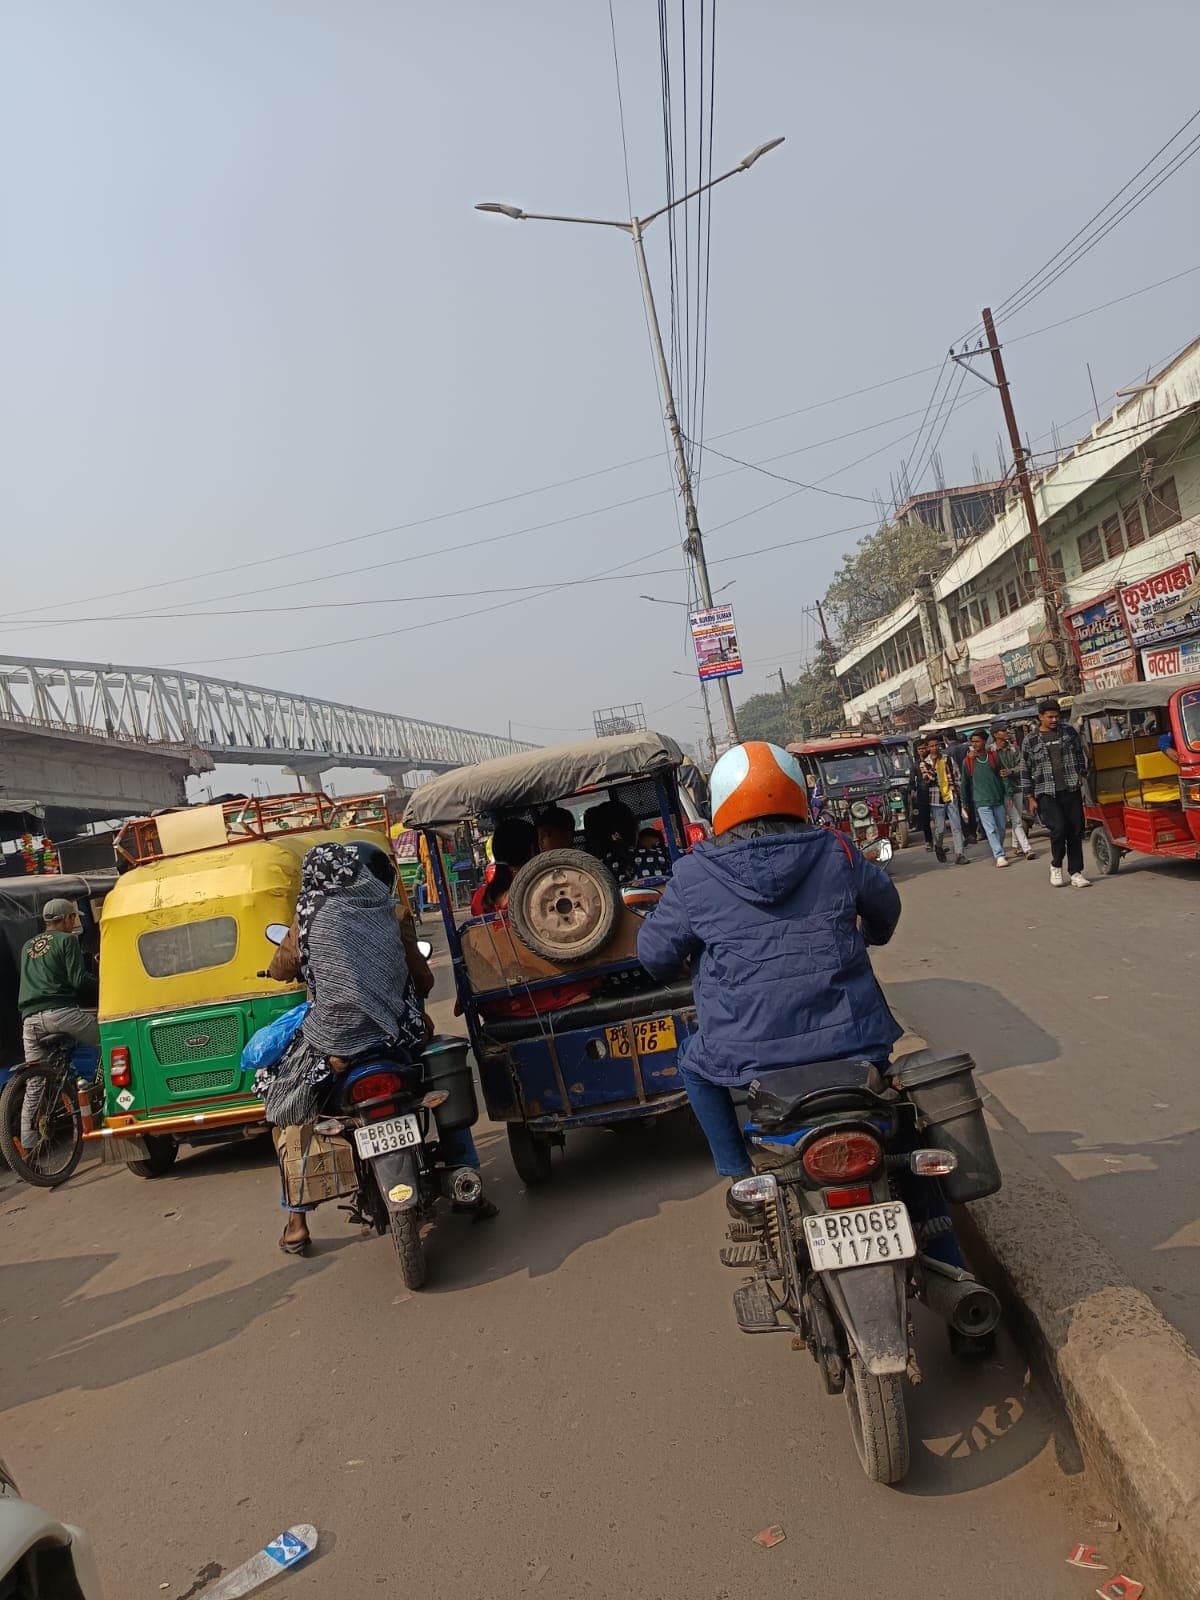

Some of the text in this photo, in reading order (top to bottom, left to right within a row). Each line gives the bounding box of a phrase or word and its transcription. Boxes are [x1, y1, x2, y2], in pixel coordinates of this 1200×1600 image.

[1121, 562, 1193, 615] कुशवाहा
[368, 1118, 412, 1141] BR06A
[372, 1131, 415, 1154] W3380
[824, 1208, 898, 1240] BR06B
[831, 1232, 904, 1265] Y1781
